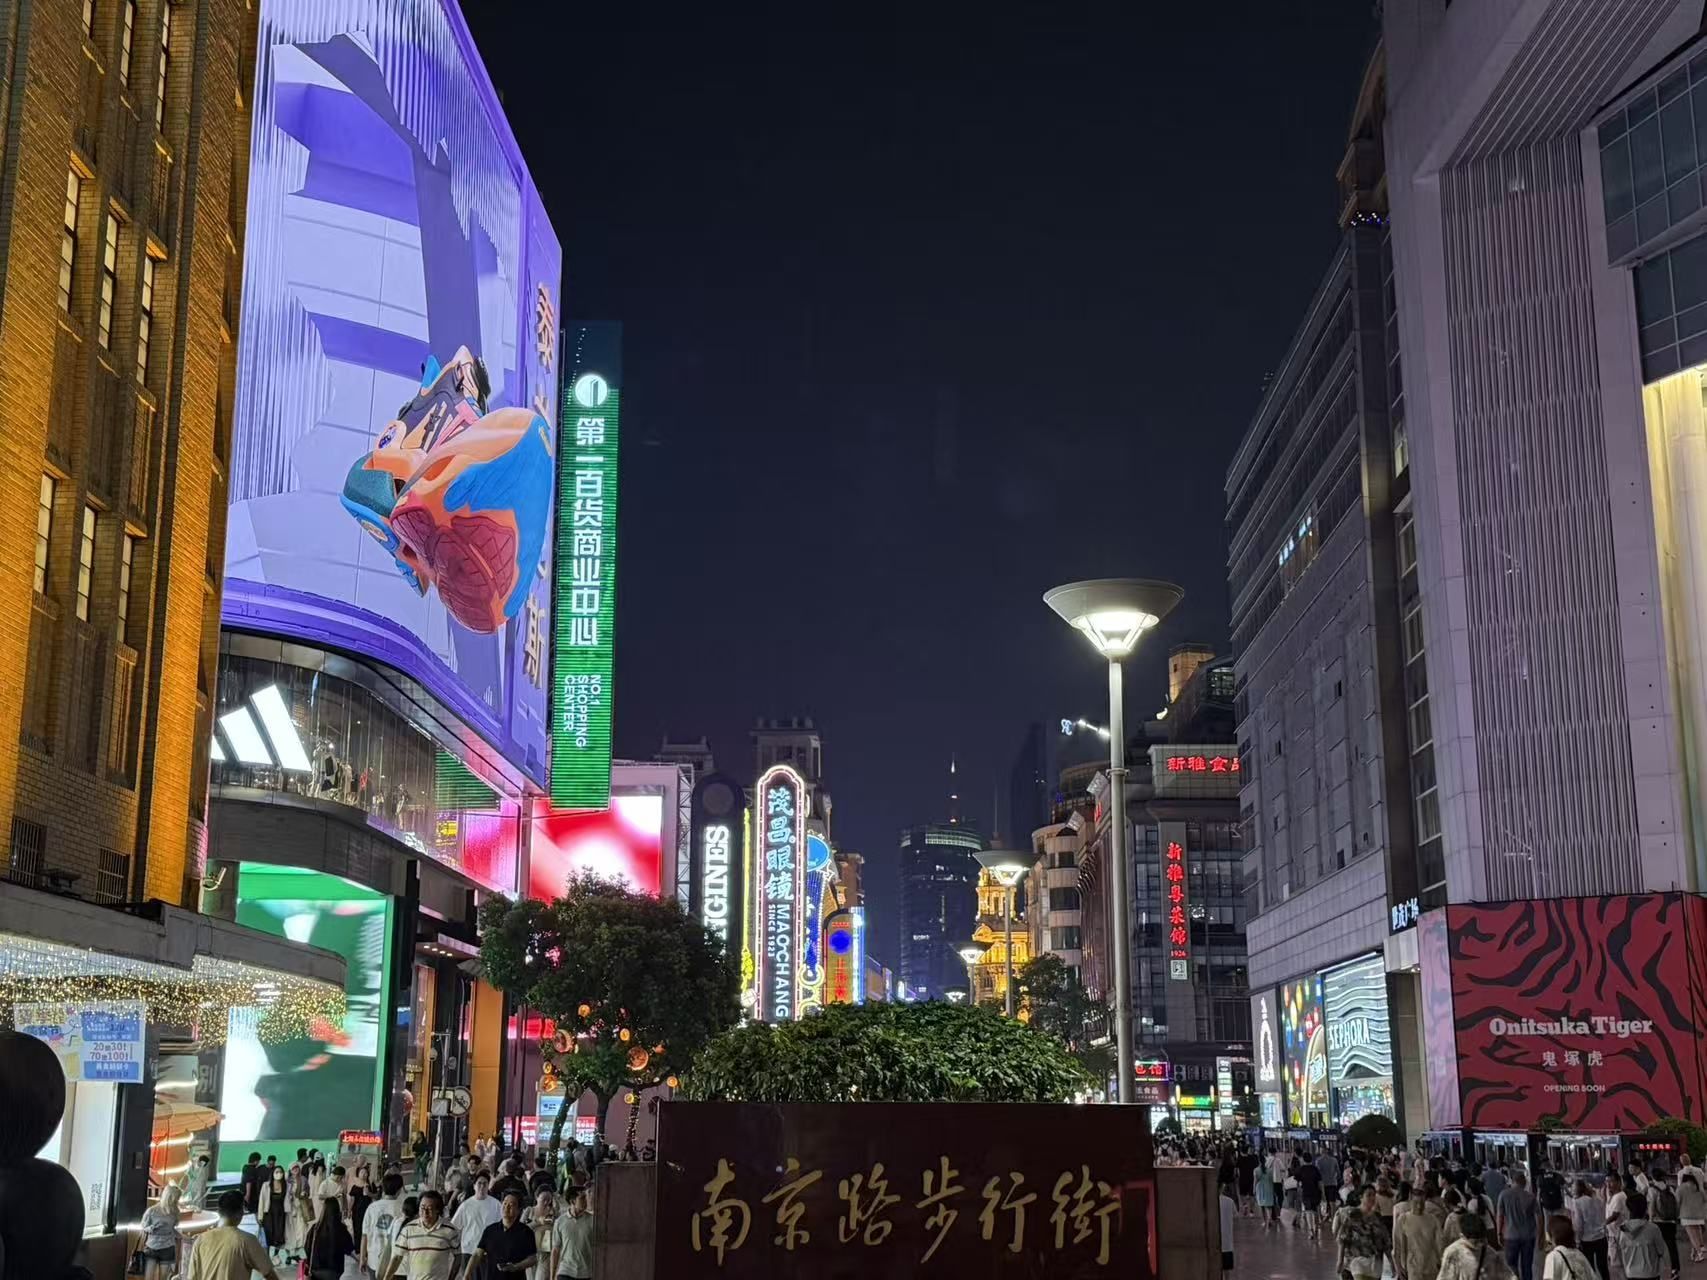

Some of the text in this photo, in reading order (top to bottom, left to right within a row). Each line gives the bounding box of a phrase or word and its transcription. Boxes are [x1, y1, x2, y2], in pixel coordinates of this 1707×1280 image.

[569, 416, 606, 648] 第一百货商业中心
[564, 675, 575, 732] CENTER
[575, 675, 588, 748] SHOPPING
[590, 675, 601, 705] NO.1
[763, 786, 795, 901] 茂昌眼镜
[1166, 841, 1188, 946] 新雅粤菜馆
[767, 904, 776, 957] SINCE 1923
[1170, 950, 1187, 958] 1926
[1328, 1017, 1371, 1051] SEPHORA
[1489, 1016, 1654, 1039] Onitsuka Tiger
[1541, 1050, 1604, 1068] 鬼塚虎
[1543, 1084, 1606, 1093] OPENING SOON
[691, 1155, 1122, 1266] 南京路步行街
